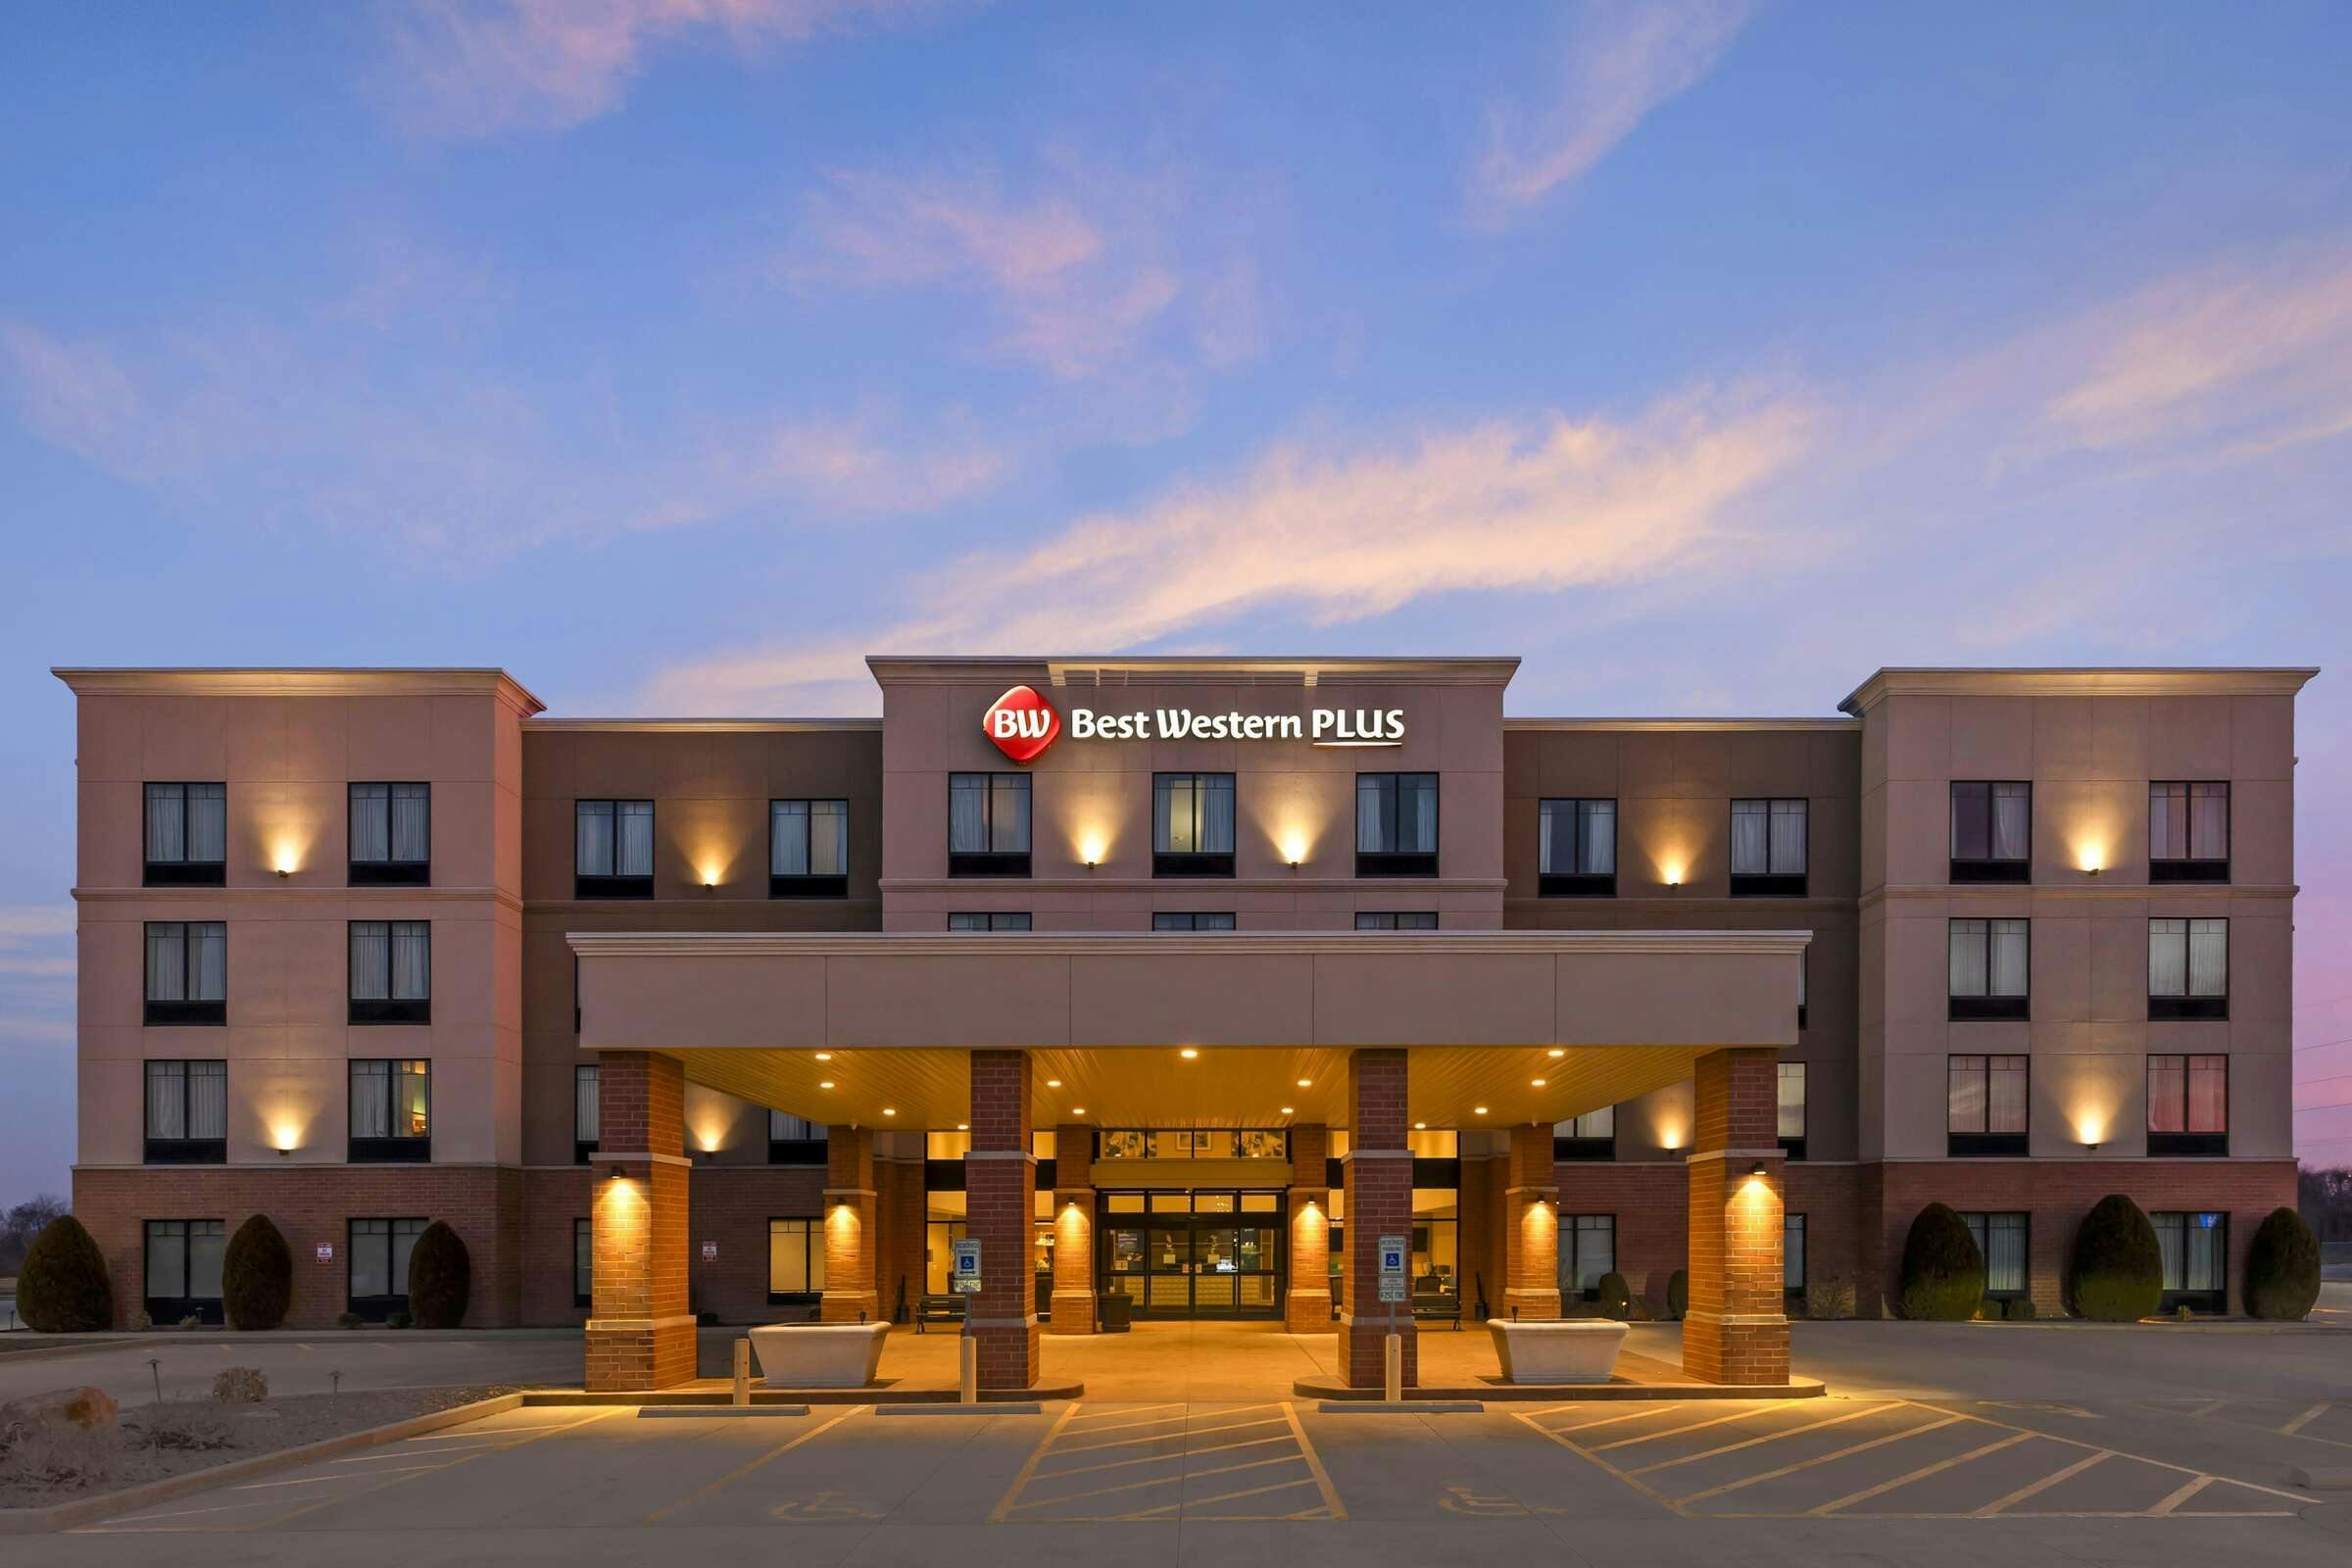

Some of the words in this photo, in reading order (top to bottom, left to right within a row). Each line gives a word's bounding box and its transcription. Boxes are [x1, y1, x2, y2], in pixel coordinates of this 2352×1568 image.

[994, 709, 1051, 738] BW
[1071, 709, 1151, 739] Best
[1155, 709, 1303, 739] Western
[1312, 709, 1405, 739] PLUS
